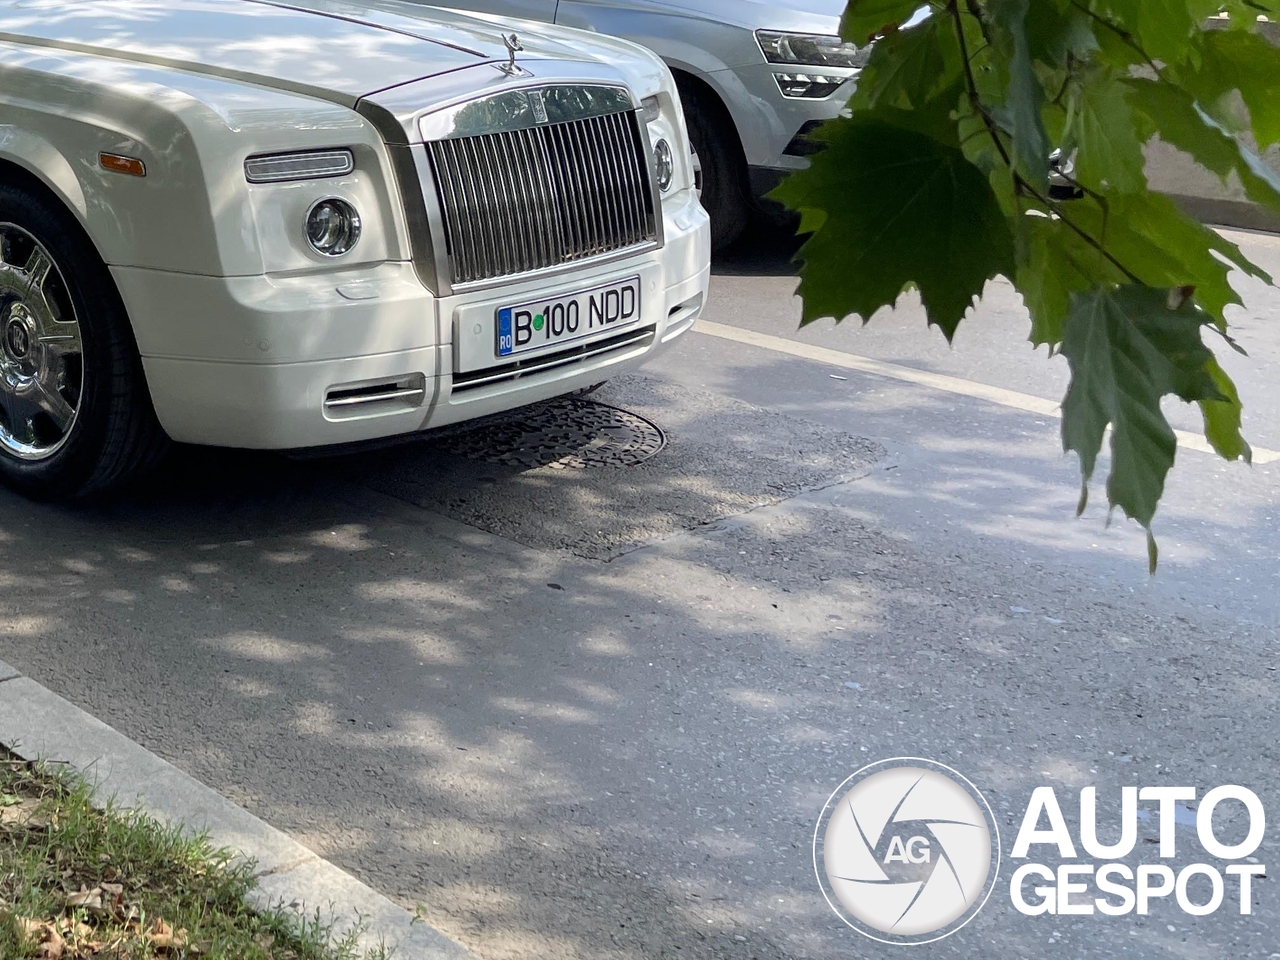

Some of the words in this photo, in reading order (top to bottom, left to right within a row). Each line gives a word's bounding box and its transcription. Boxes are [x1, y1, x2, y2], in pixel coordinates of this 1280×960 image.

[514, 310, 532, 346] B
[543, 299, 580, 339] 100
[588, 285, 636, 328] NDD
[499, 334, 511, 350] RO
